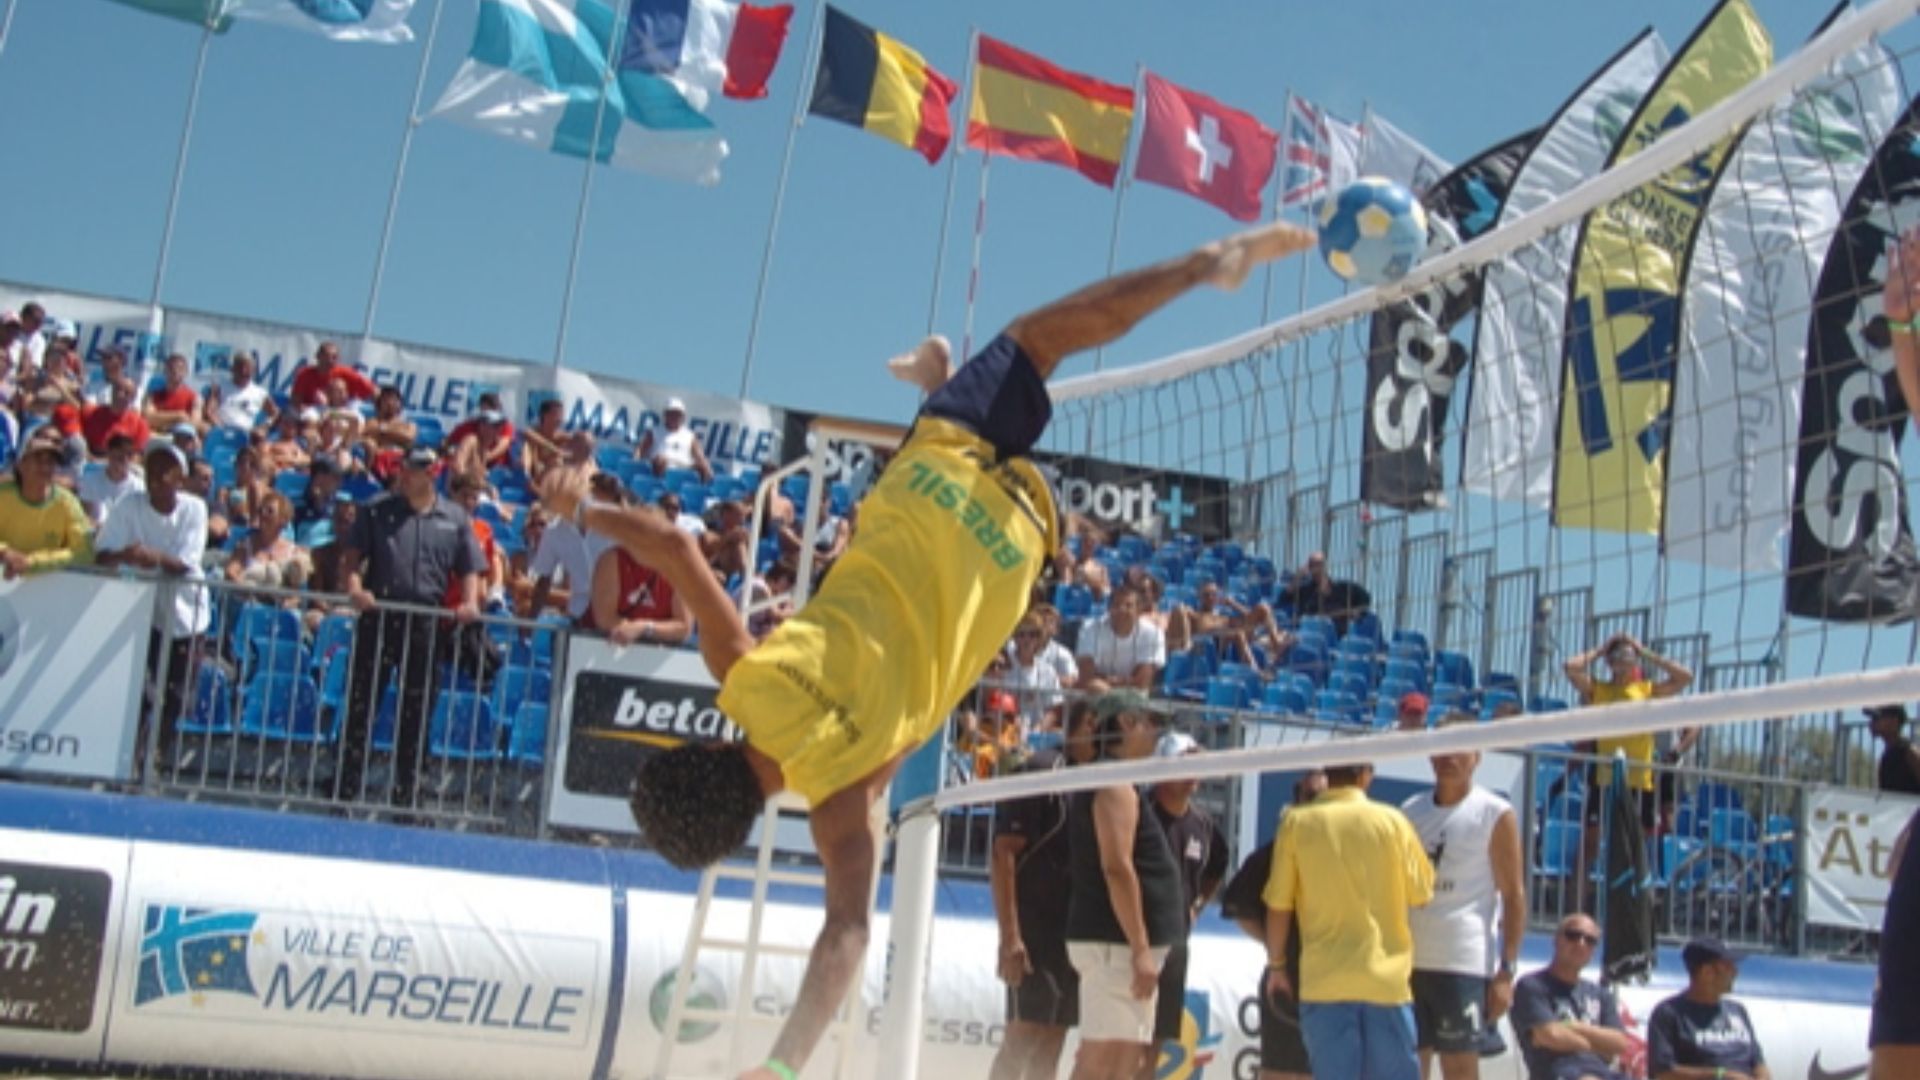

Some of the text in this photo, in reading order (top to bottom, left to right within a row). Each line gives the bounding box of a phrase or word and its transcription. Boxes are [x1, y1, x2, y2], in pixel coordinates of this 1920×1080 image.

[565, 396, 775, 465] MAREILLE
[0, 728, 79, 758] son
[283, 926, 413, 965] VILLE DE
[262, 962, 583, 1033] MARSEILLE
[1463, 1001, 1481, 1031] 1
